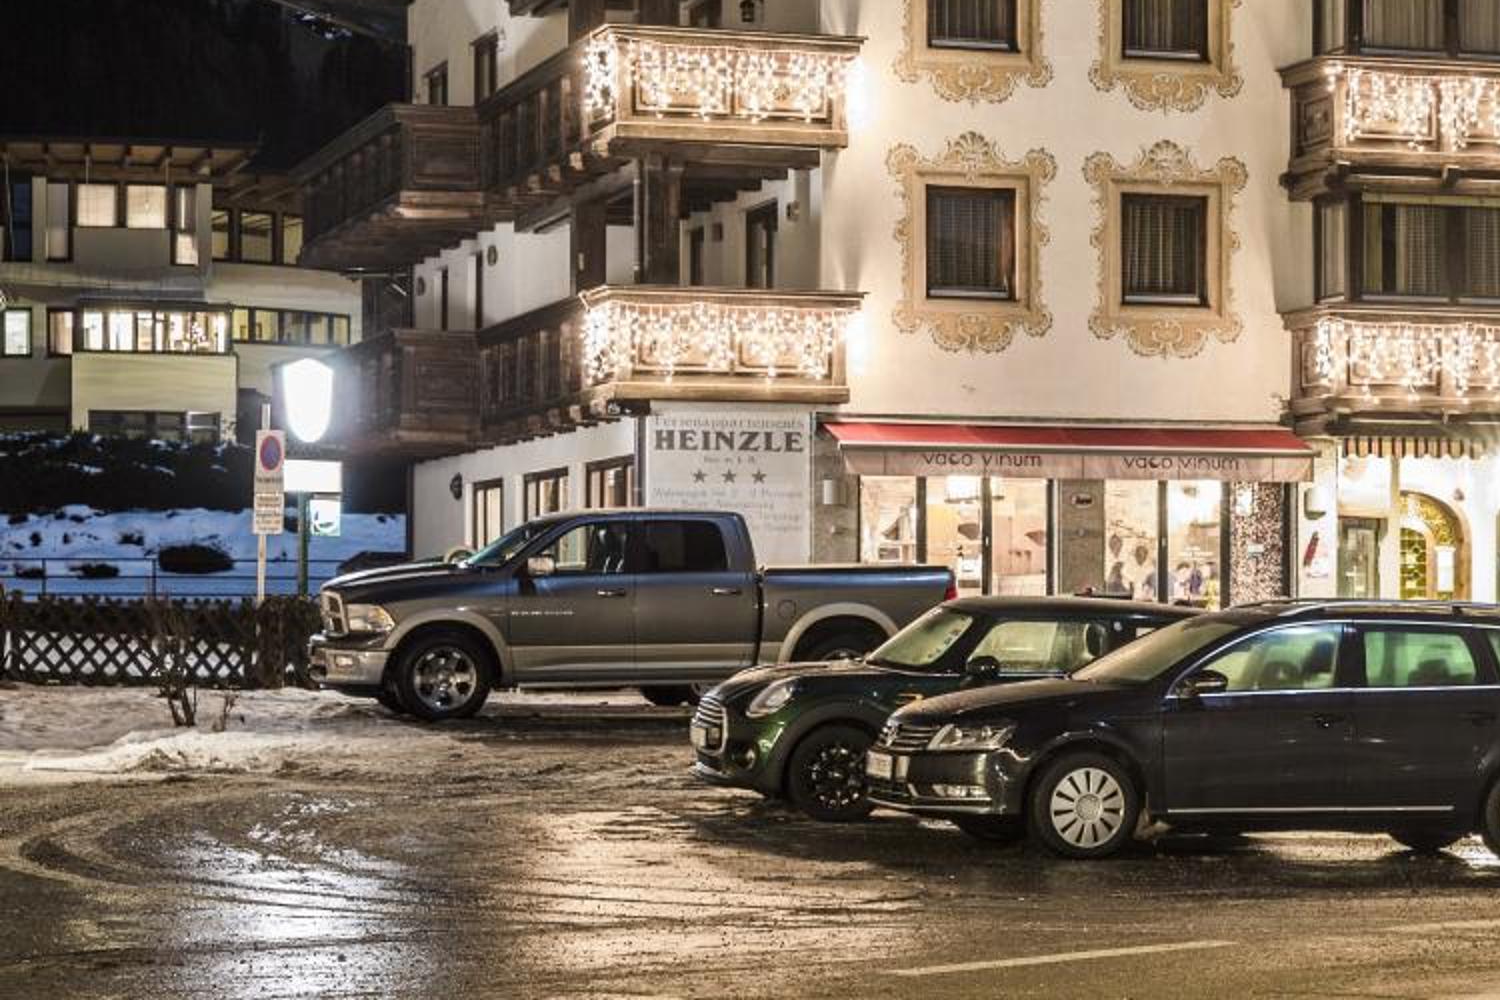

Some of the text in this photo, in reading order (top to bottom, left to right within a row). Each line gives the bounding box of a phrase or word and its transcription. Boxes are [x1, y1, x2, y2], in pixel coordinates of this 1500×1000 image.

[655, 429, 805, 453] HEINZLE
[922, 453, 1042, 467] vaco vinum
[1123, 456, 1239, 471] vaco vinum
